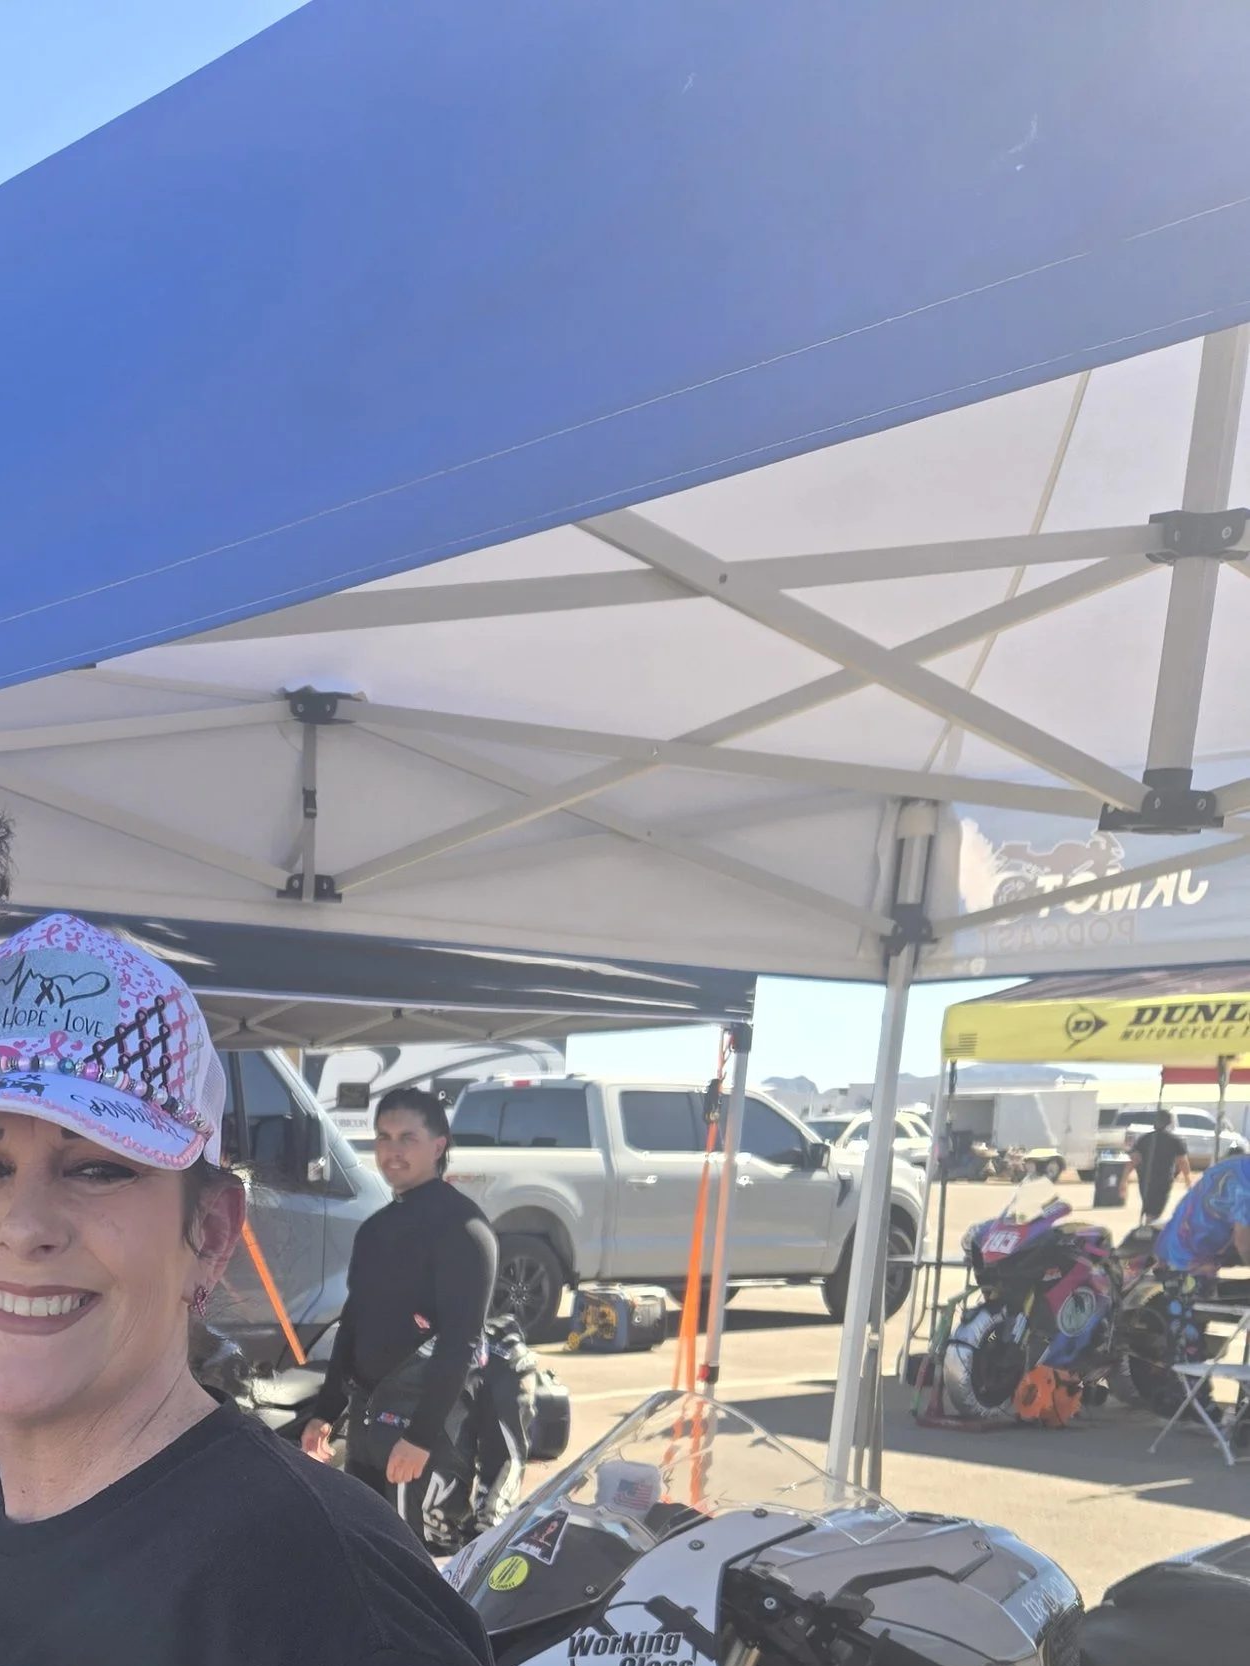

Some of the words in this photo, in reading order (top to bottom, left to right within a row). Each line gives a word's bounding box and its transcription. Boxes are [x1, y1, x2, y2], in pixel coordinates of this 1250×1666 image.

[1, 1007, 49, 1029] HOPE
[64, 1009, 104, 1038] LOVE
[1127, 1003, 1250, 1026] DUNL
[1119, 1025, 1235, 1040] MOTORCYCLE
[567, 1630, 685, 1659] Working
